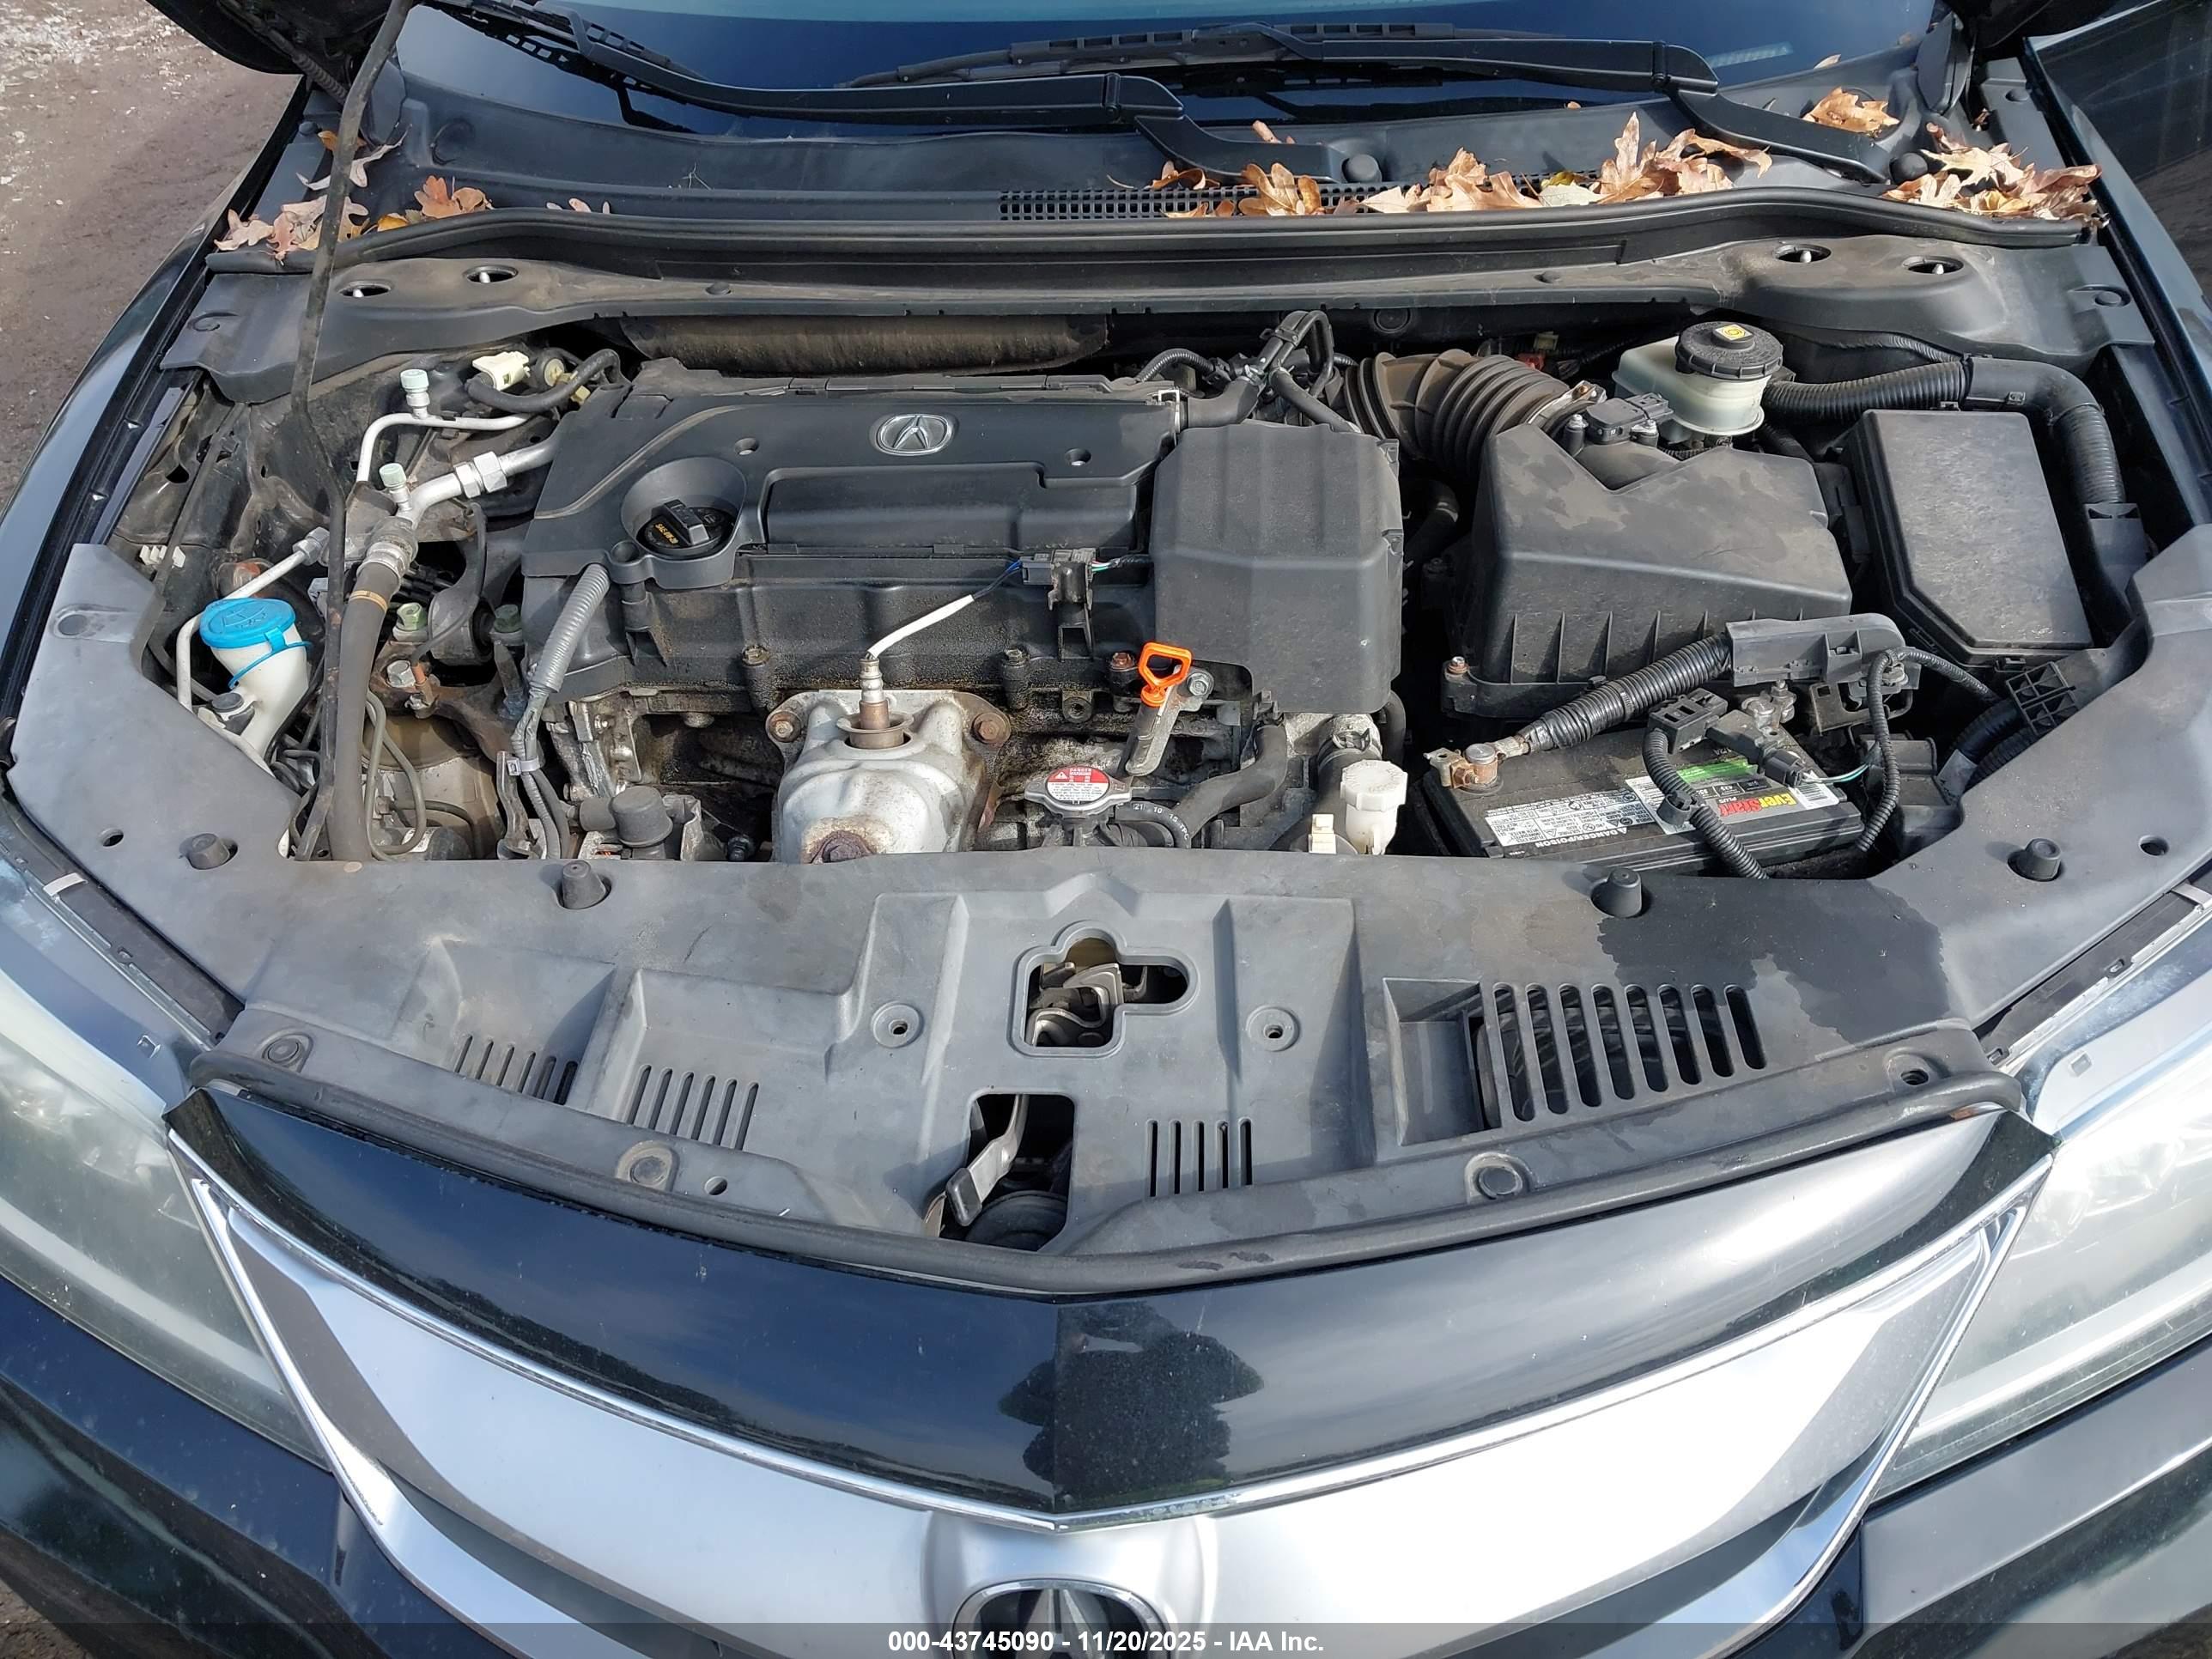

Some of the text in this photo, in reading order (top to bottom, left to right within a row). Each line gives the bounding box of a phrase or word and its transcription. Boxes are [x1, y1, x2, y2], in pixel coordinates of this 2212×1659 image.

[1718, 795, 1737, 805] PLUS
[1719, 793, 1796, 817] EverStart
[1535, 829, 1619, 848] DANGER/POISON
